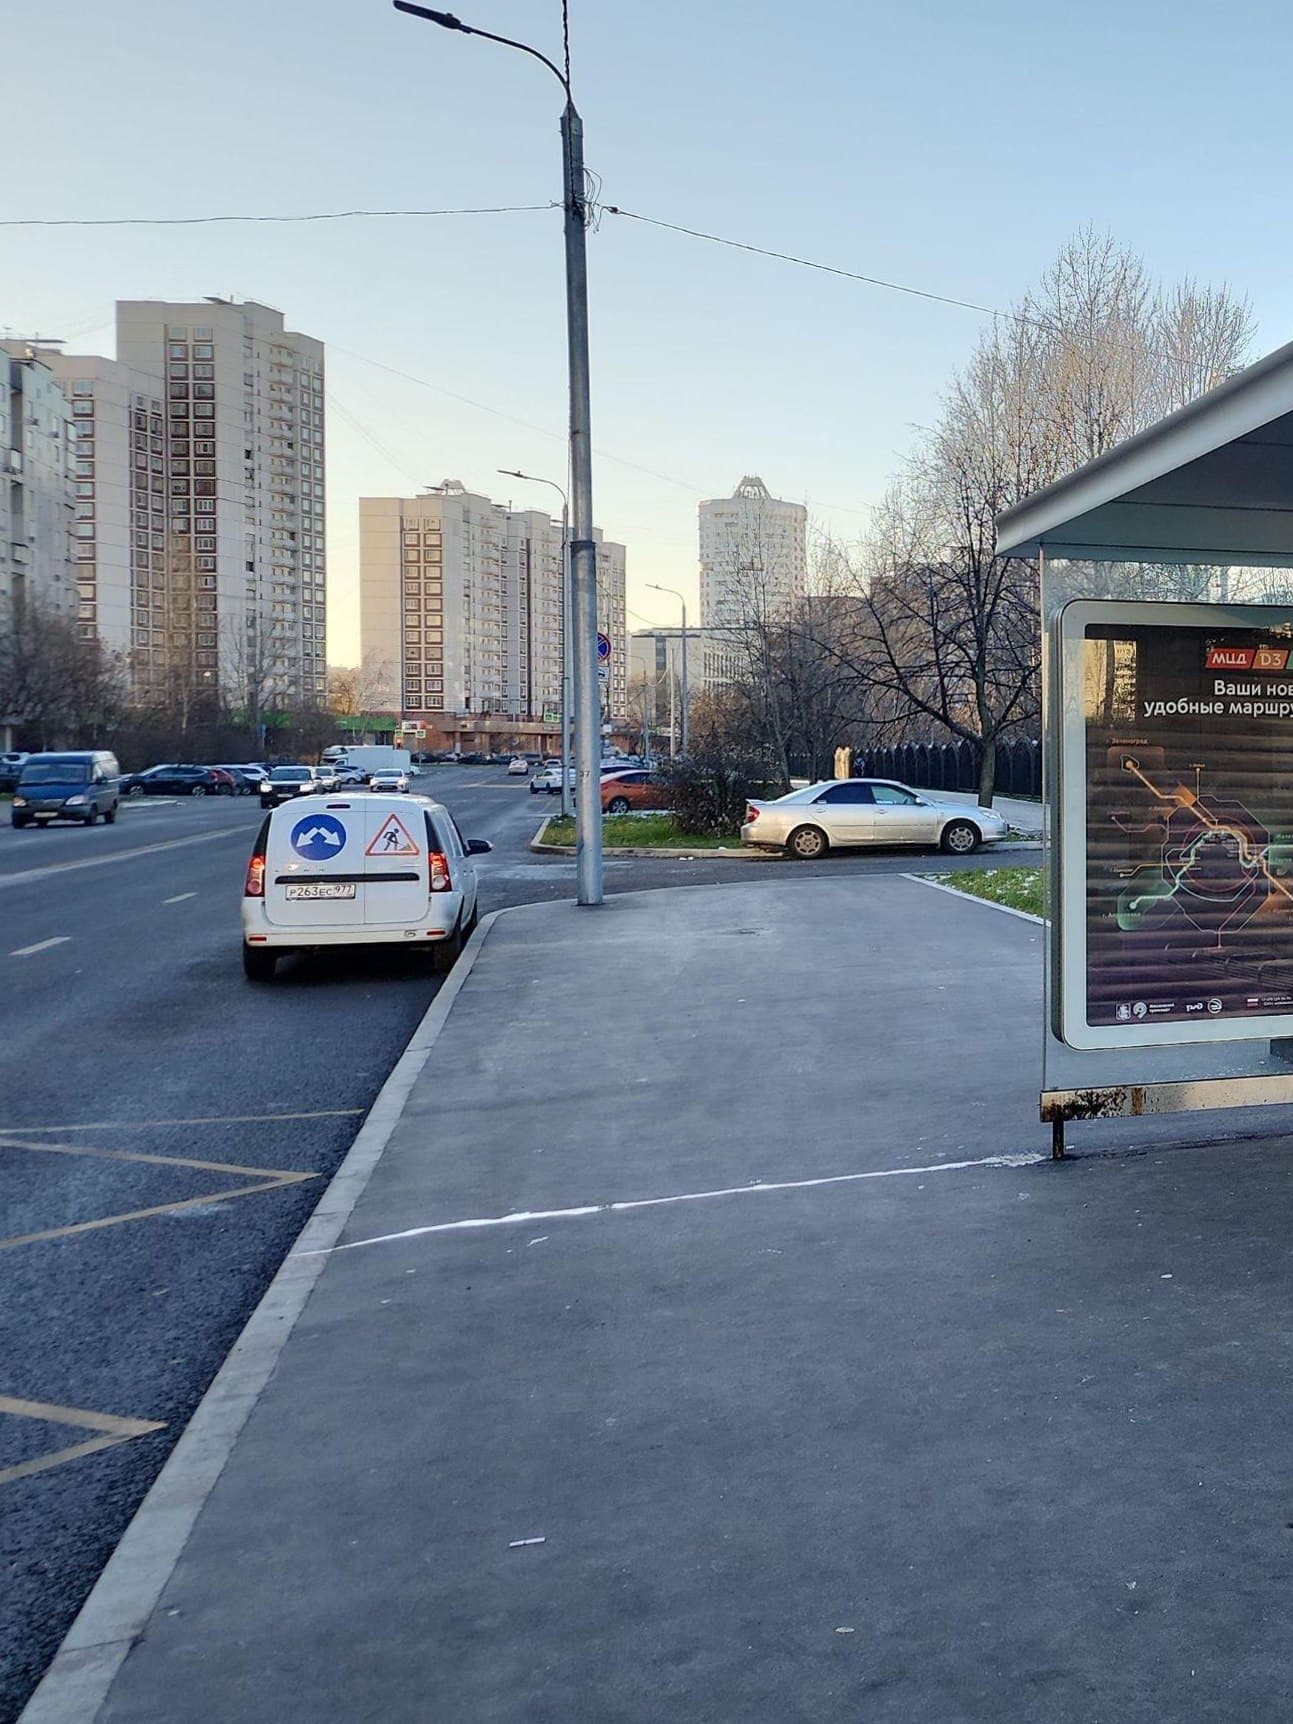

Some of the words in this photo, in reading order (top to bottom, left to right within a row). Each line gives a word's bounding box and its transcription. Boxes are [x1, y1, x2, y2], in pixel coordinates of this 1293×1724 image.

[1211, 652, 1247, 665] МЦД
[1214, 680, 1261, 696] Ваши
[1143, 698, 1224, 717] удобные
